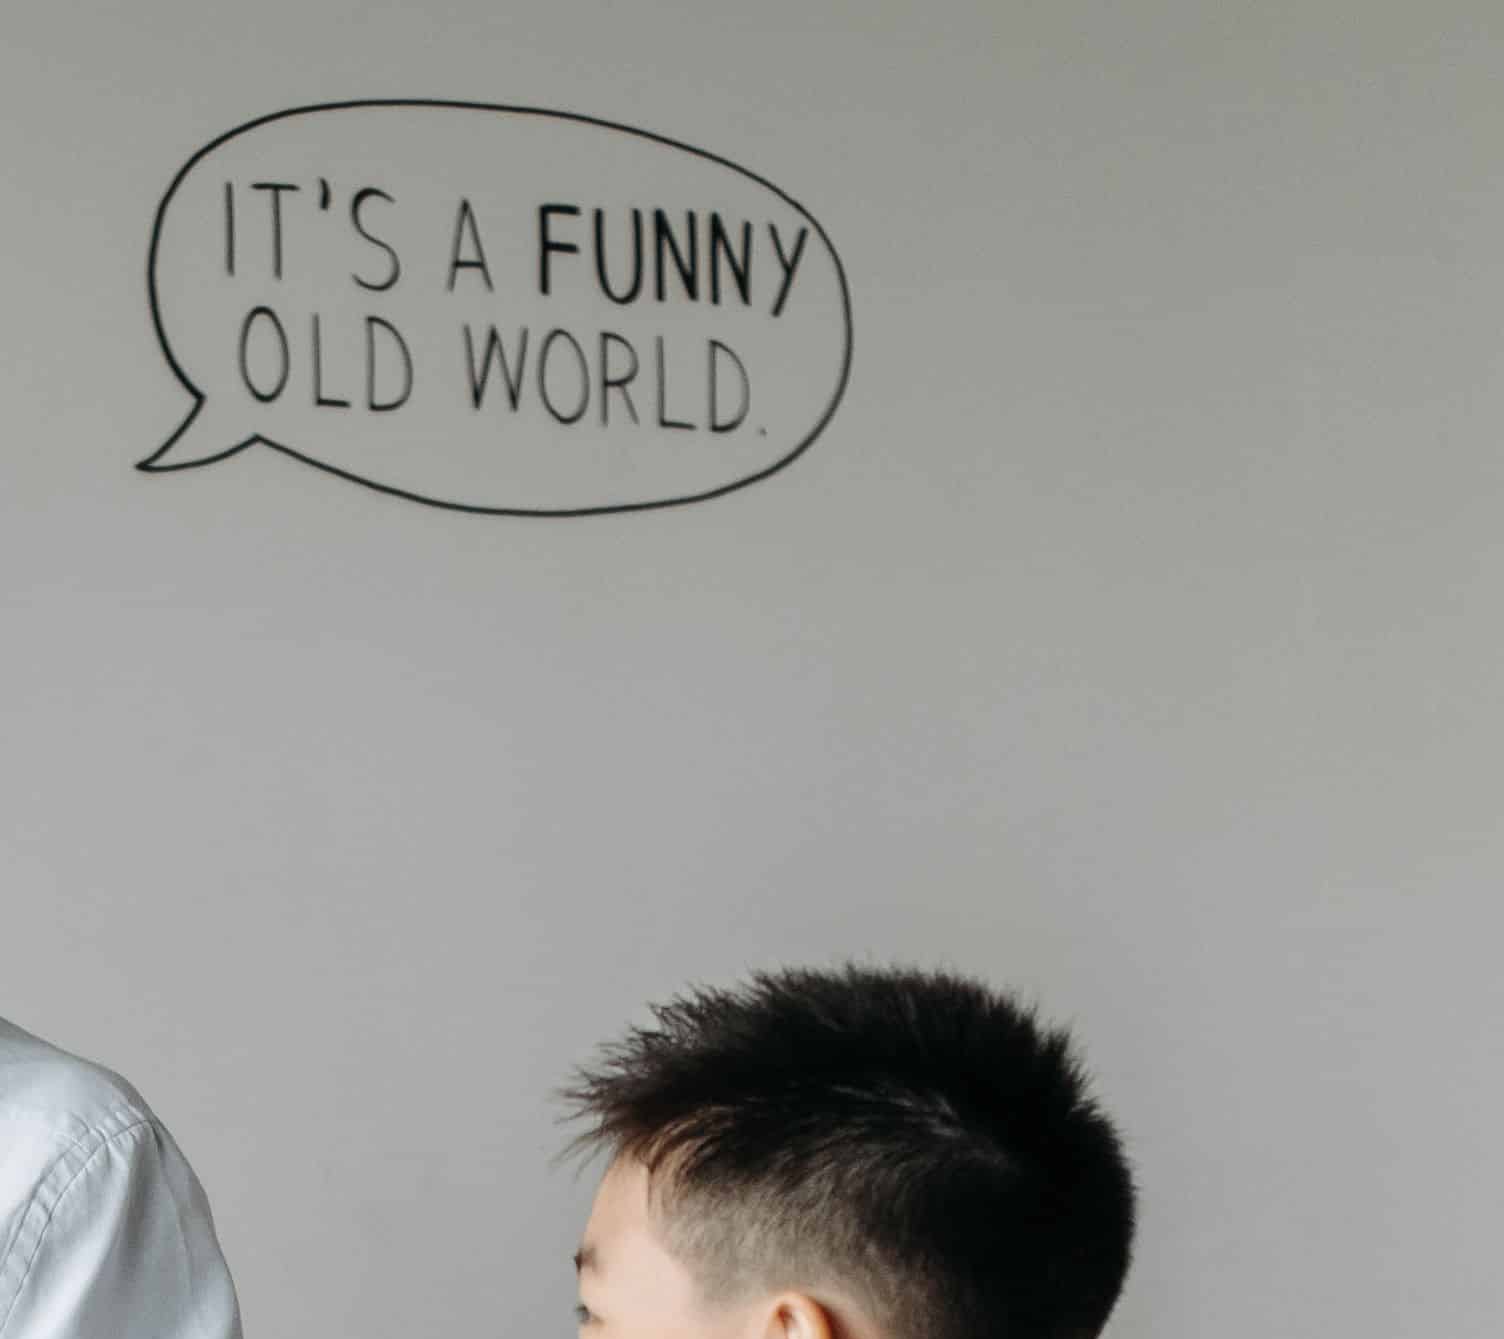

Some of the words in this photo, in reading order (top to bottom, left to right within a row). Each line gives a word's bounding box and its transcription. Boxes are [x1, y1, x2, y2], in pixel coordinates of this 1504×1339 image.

[224, 176, 401, 293] IT'S
[447, 197, 493, 293] A
[537, 203, 808, 318] FUNNY
[238, 305, 414, 412] OLD
